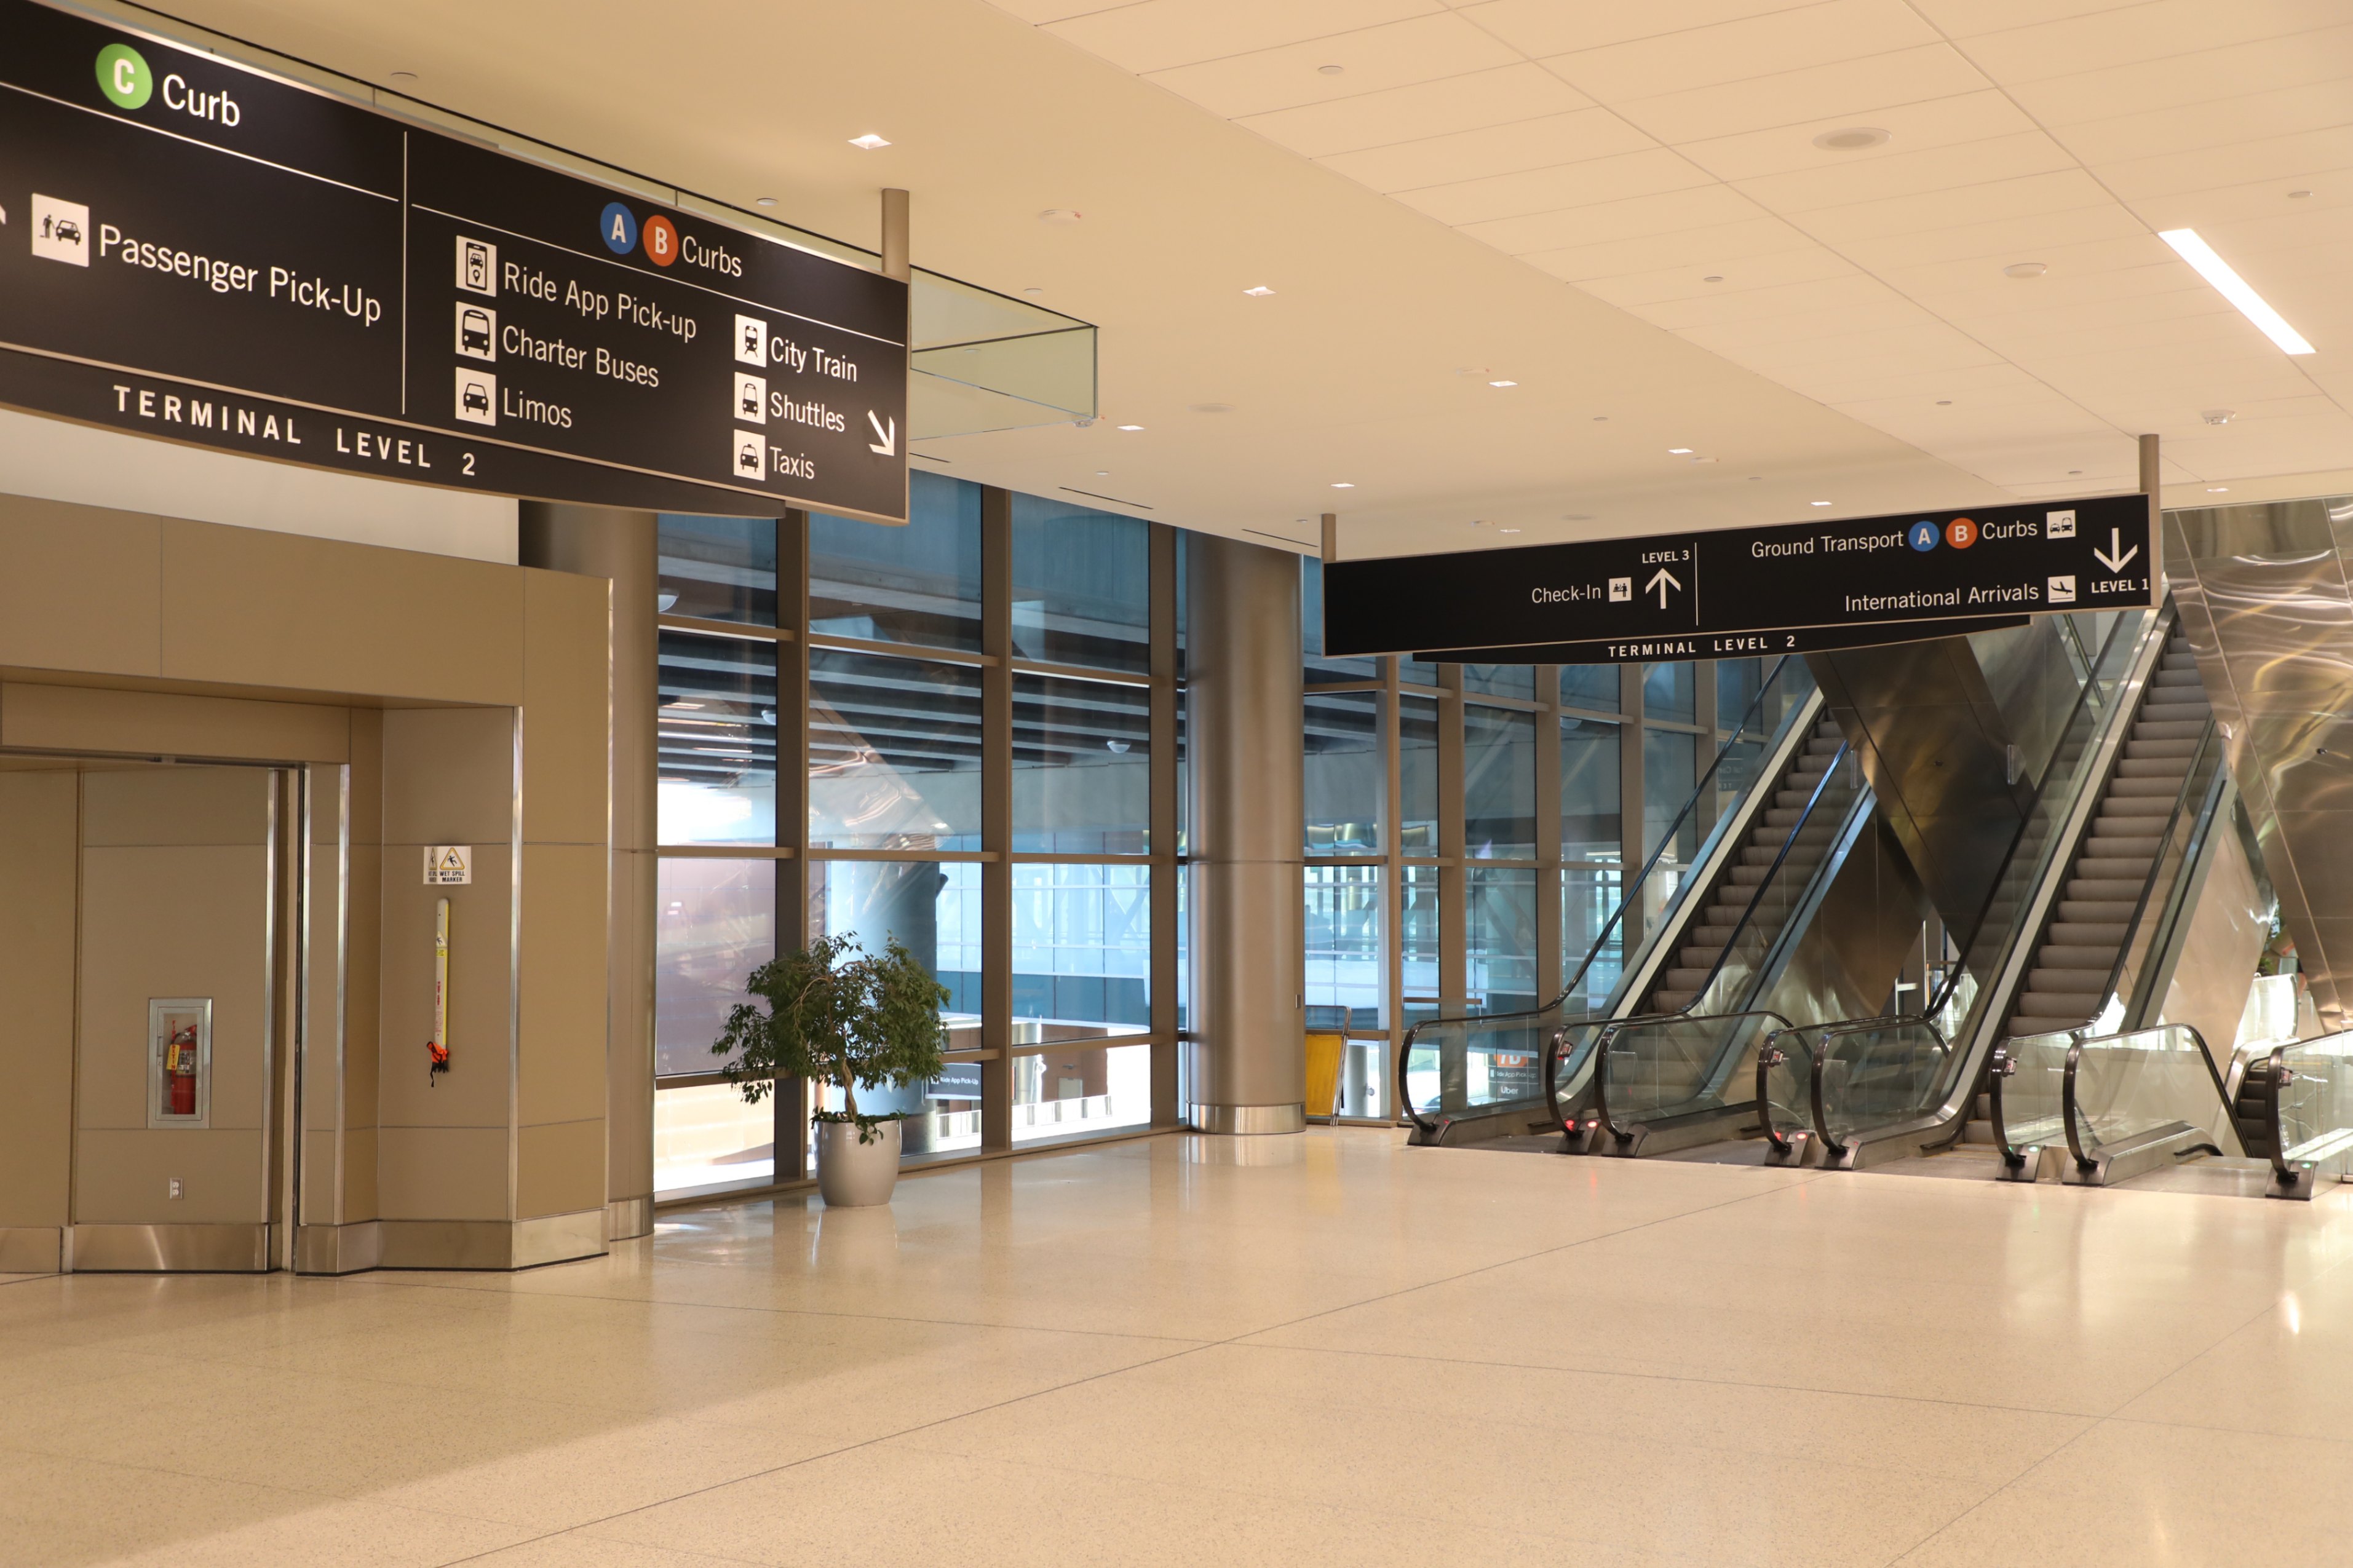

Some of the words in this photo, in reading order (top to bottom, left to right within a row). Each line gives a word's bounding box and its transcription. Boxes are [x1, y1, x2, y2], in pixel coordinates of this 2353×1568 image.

[114, 59, 135, 94] C
[164, 75, 240, 126] Curb
[611, 214, 626, 243] A
[656, 227, 667, 254] B
[683, 236, 742, 277] Curbs
[101, 224, 258, 292] Passenger
[271, 267, 380, 327] Pick-Up
[506, 263, 556, 301] Ride
[565, 280, 608, 320] App
[619, 293, 696, 343] Pick-up
[504, 326, 587, 370] Charter
[597, 348, 659, 387] Buses
[771, 337, 806, 373] City
[812, 347, 856, 382] Train
[504, 388, 571, 428] Limos
[771, 392, 844, 432] Shuttles
[114, 386, 300, 444] TERMINAL
[338, 429, 430, 467] LEVEL
[462, 453, 474, 475] 2
[770, 446, 814, 479] Taxis
[1643, 552, 1678, 563] LEVEL
[1682, 550, 1689, 560] 3
[1752, 537, 1813, 557] Ground
[1821, 531, 1903, 552] Transport
[1918, 528, 1930, 544] A
[1955, 526, 1967, 542] B
[1983, 521, 2037, 539] Curbs
[1532, 584, 1600, 603] Check-In
[1846, 588, 1959, 611] International
[1968, 584, 2038, 603] Arrivals
[2092, 580, 2136, 593] LEVEL
[2142, 579, 2148, 590] 1
[1608, 642, 1696, 657] TERMINAL
[1715, 638, 1768, 651] LEVEL
[1787, 636, 1795, 647] 2
